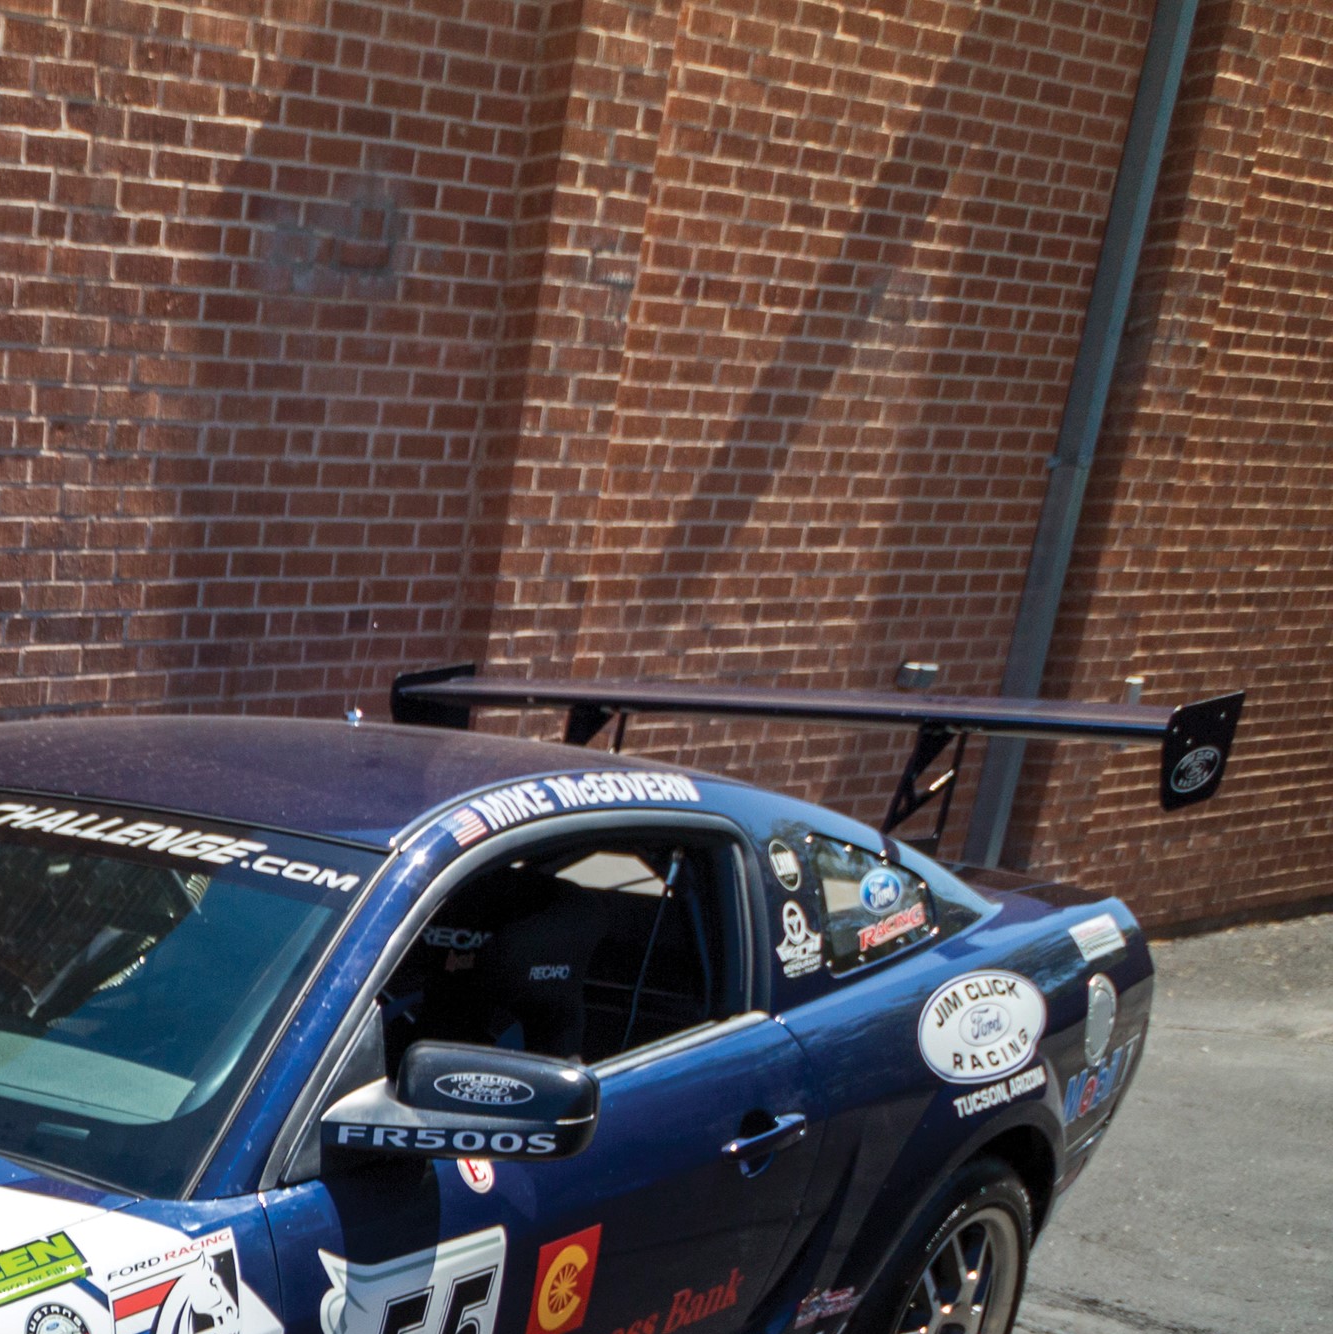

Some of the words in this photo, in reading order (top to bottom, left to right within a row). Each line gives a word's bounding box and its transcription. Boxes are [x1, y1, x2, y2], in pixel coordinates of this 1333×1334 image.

[470, 781, 555, 831] MIKE
[543, 772, 700, 809] McGOVERN
[868, 874, 897, 909] Ford
[422, 926, 494, 949] RECA
[857, 902, 926, 951] RACING
[529, 964, 571, 981] RECARO
[935, 991, 964, 1028] JIM
[964, 979, 1021, 1001] CLICK
[970, 1008, 1003, 1040] Ford
[953, 1029, 1028, 1070] RACING
[450, 1073, 476, 1084] JIM
[479, 1074, 520, 1090] CLICK
[451, 1089, 513, 1103] RACING
[953, 1085, 1010, 1118] TUCSON,
[1010, 1065, 1046, 1098] ARIZONA
[337, 1125, 557, 1154] FR500S
[107, 1256, 161, 1282] FORD
[164, 1231, 232, 1262] RACING
